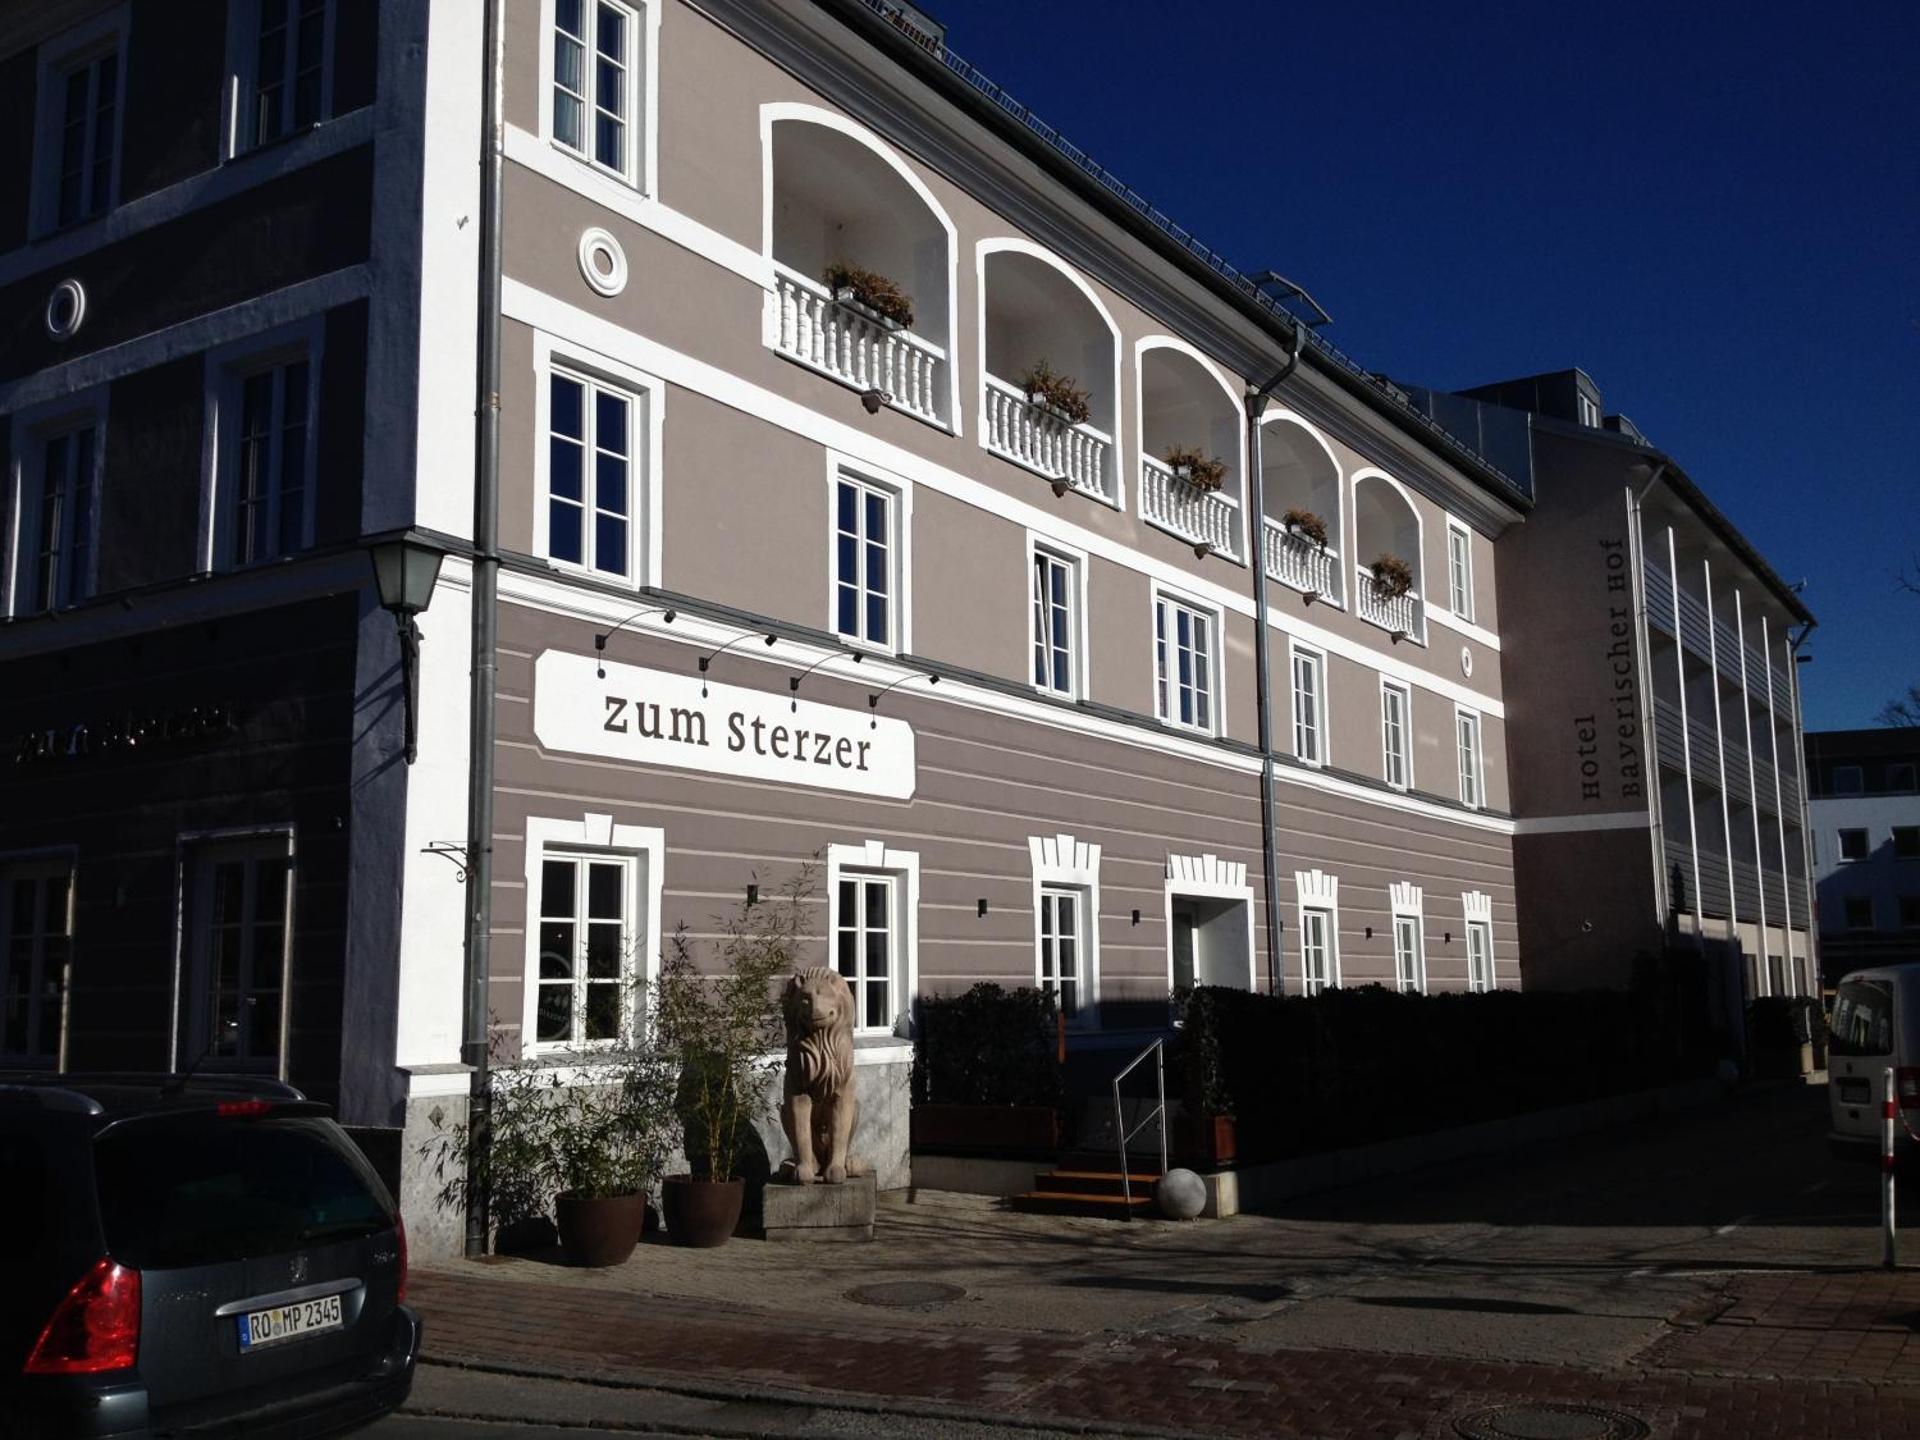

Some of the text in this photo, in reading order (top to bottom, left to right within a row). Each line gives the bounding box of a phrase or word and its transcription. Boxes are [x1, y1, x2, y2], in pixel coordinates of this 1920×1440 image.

[1599, 539, 1640, 798] Bayerischer Hof
[603, 695, 871, 771] zum Sterzer
[1575, 714, 1600, 800] Hotel
[250, 1312, 271, 1341] RO
[282, 1306, 302, 1333] MP
[305, 1297, 340, 1327] 2345
